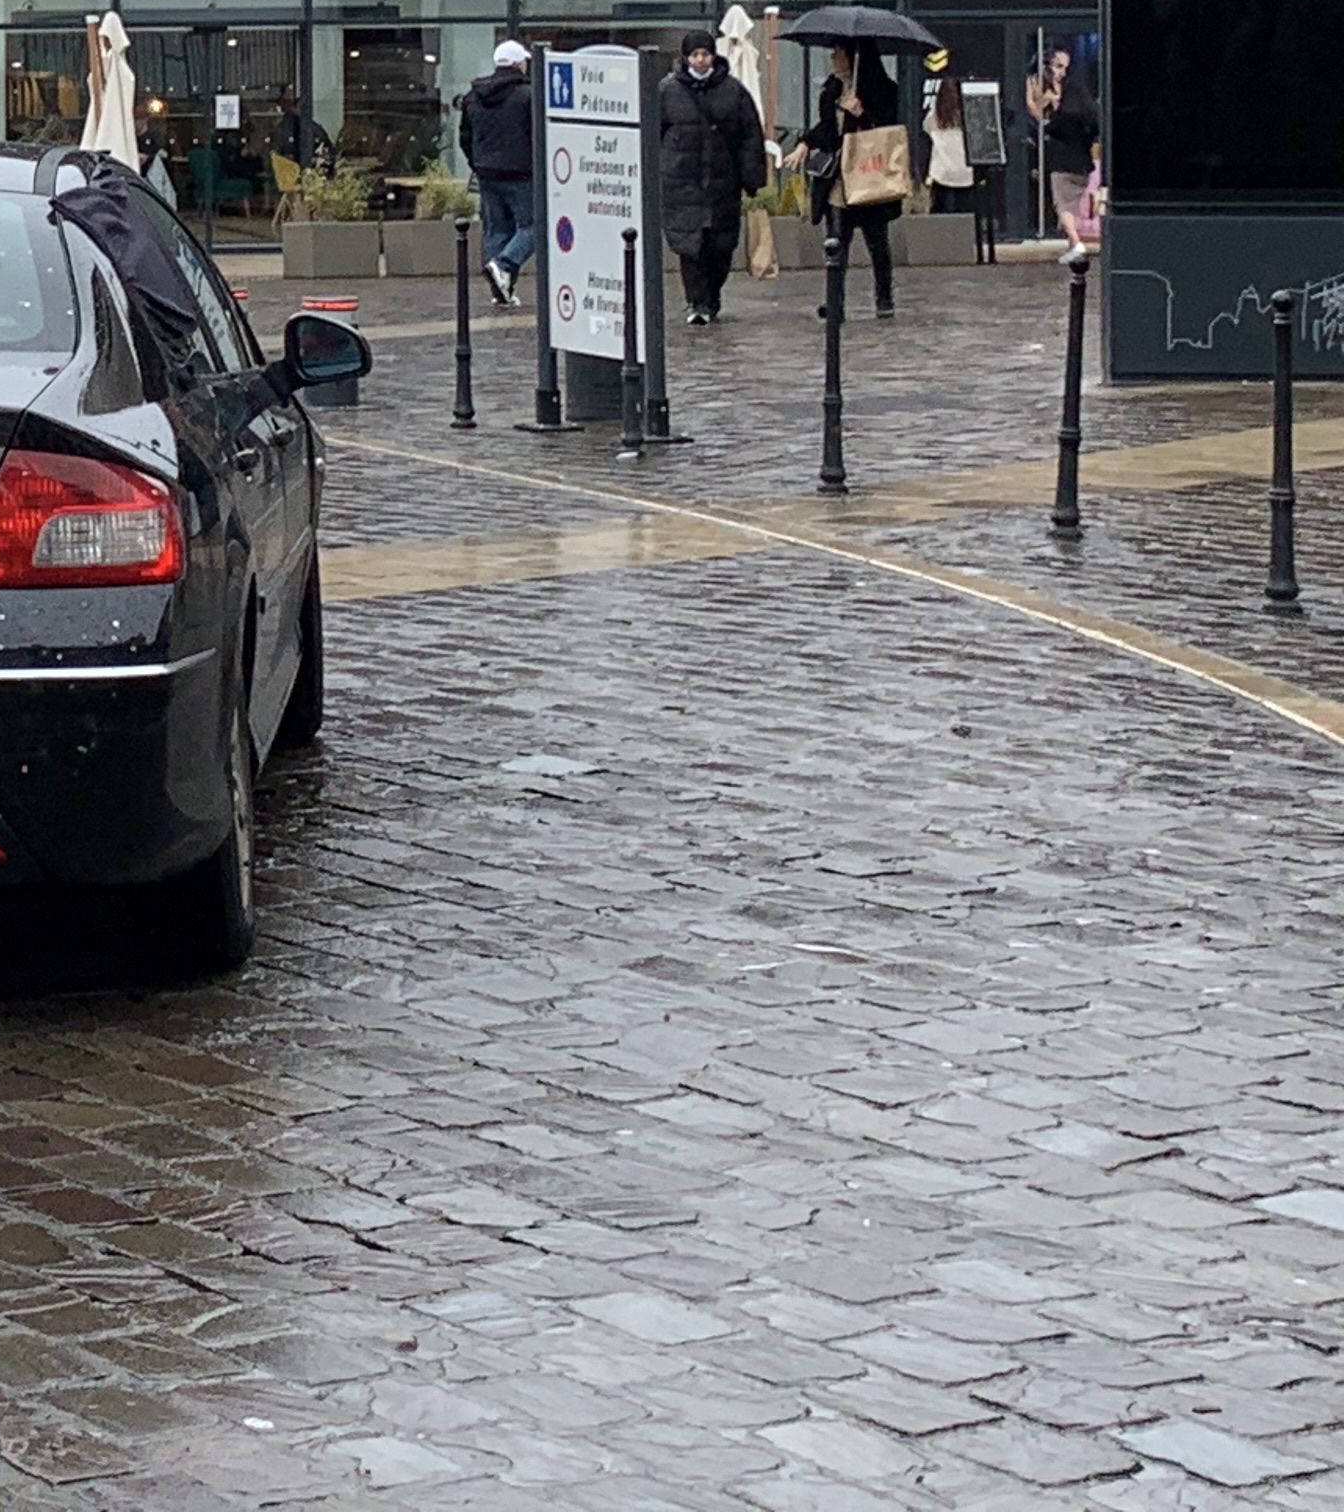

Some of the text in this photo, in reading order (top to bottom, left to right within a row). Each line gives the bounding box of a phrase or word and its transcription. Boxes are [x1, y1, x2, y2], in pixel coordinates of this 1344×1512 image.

[580, 65, 605, 85] Voie
[580, 93, 630, 115] Piétonne
[593, 135, 618, 155] Sauf
[578, 155, 639, 178] livraisons et
[586, 177, 632, 198] véhicules
[587, 200, 632, 219] autorisés
[587, 271, 623, 292] Horaire
[582, 292, 594, 311] de
